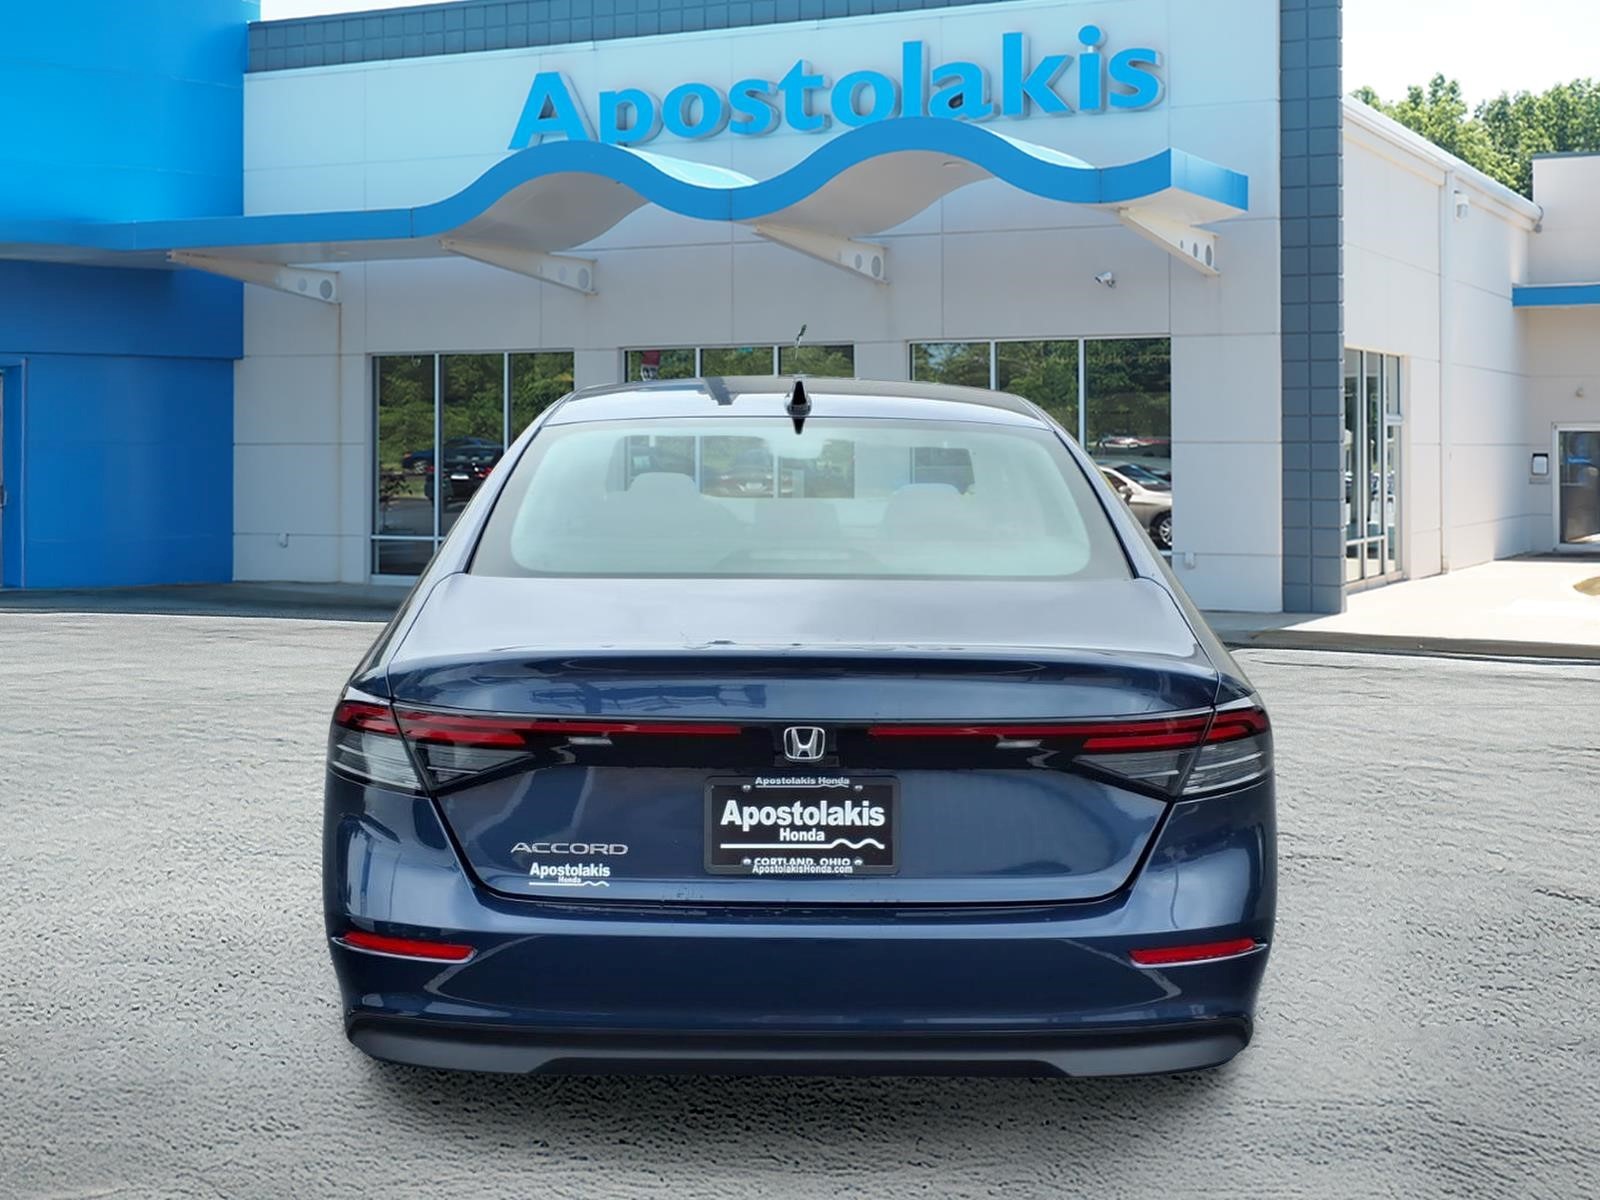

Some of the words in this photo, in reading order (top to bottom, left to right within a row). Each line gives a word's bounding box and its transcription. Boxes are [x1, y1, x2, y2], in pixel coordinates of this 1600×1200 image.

[508, 24, 1164, 150] Apostolakis
[755, 776, 817, 787] Apostolakis
[818, 776, 850, 786] Honda
[720, 799, 886, 832] Apostolakis
[779, 828, 825, 842] Honda
[510, 842, 629, 855] ACCORD
[820, 857, 851, 866] OHIO
[529, 862, 611, 879] Apostolakis
[752, 864, 853, 875] ApostolakisHonda.com
